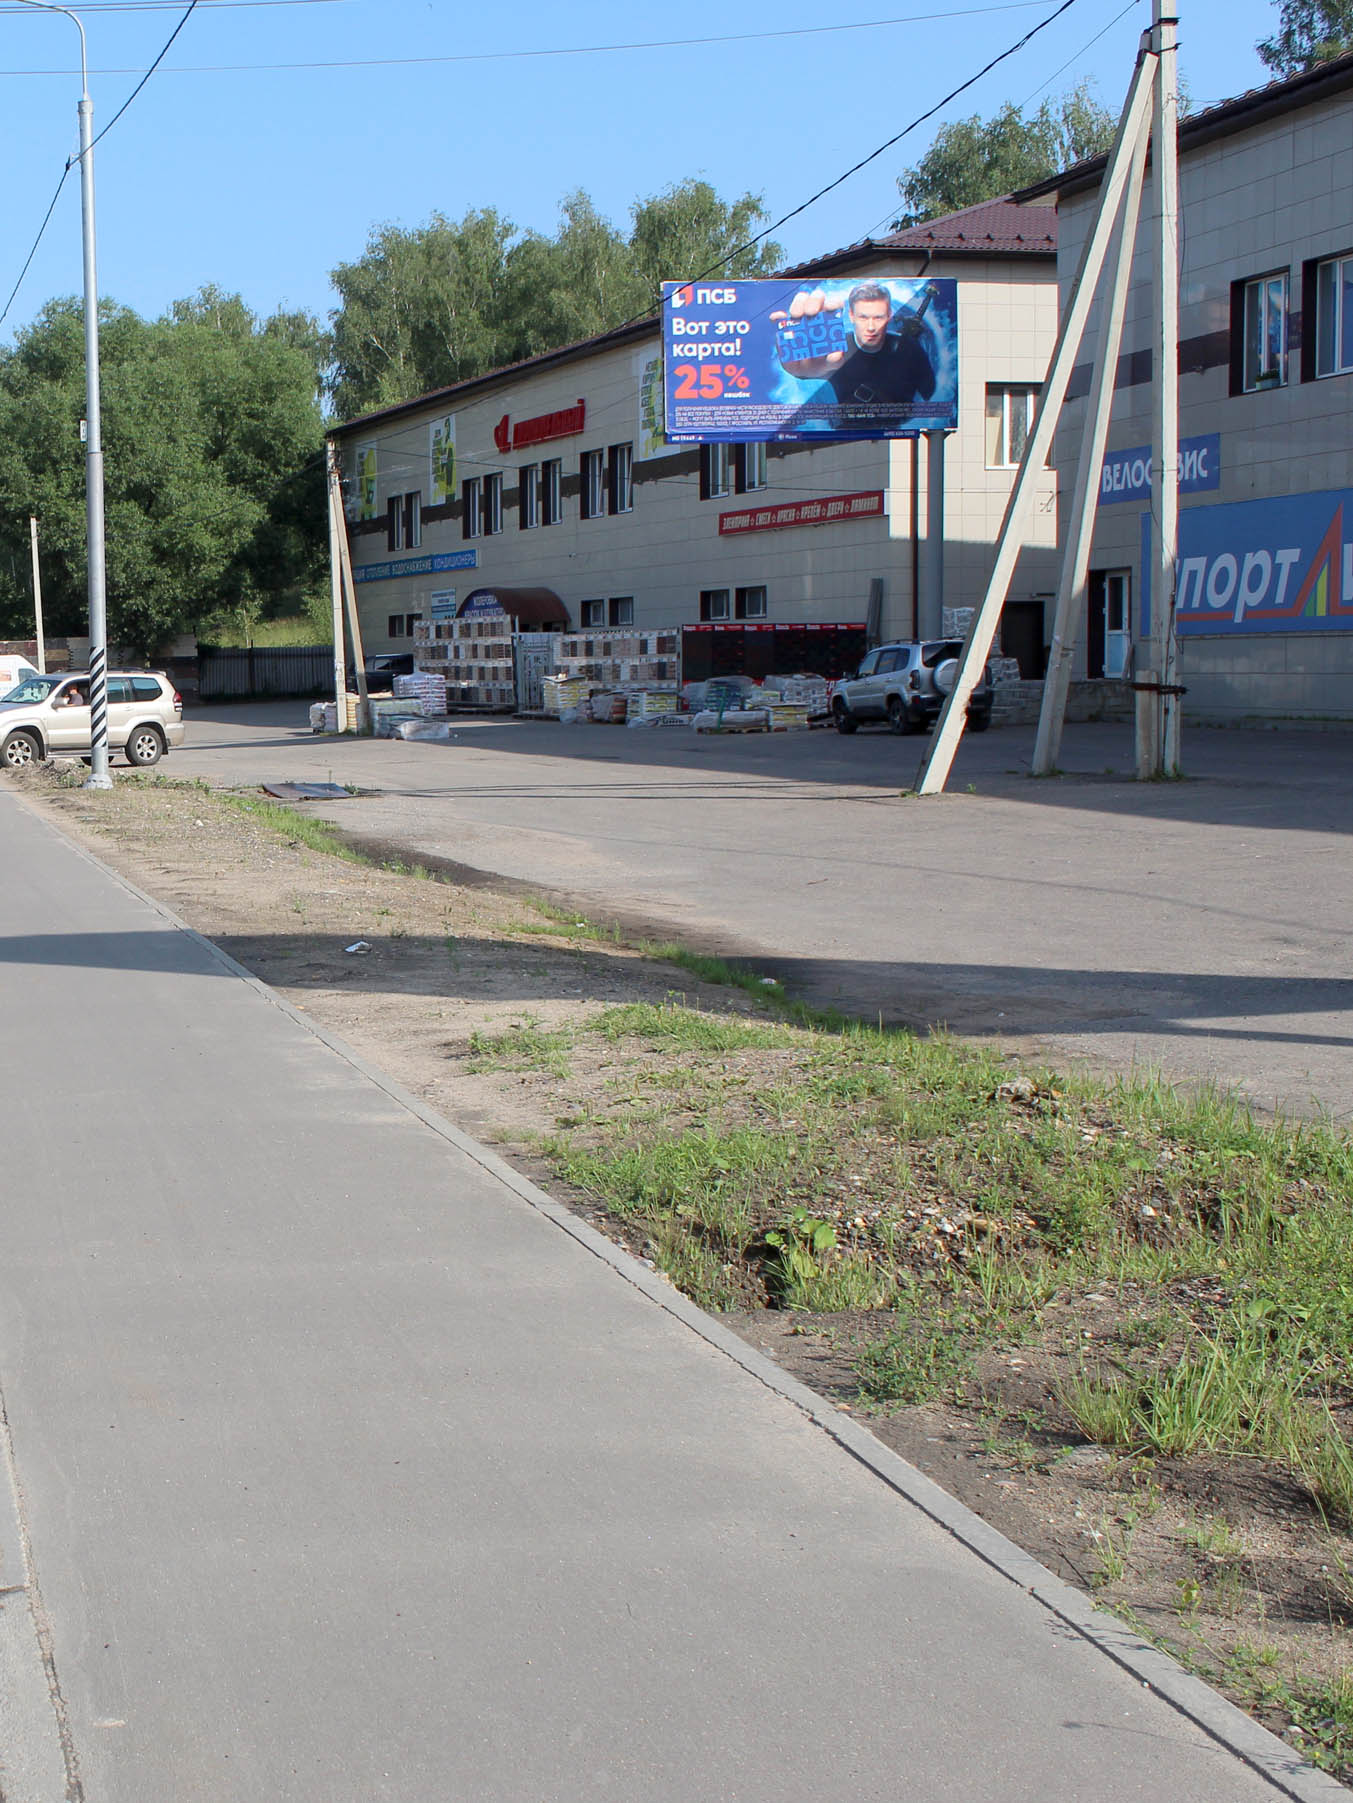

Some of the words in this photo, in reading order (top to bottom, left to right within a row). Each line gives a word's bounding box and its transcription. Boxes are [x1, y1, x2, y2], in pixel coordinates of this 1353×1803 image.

[697, 288, 737, 305] ПСБ
[672, 317, 710, 335] Вот
[714, 320, 751, 335] это
[672, 337, 742, 361] карта!
[673, 364, 751, 399] 25%
[1102, 448, 1208, 493] ВЕЛОСВИС
[1176, 548, 1302, 624] порт
